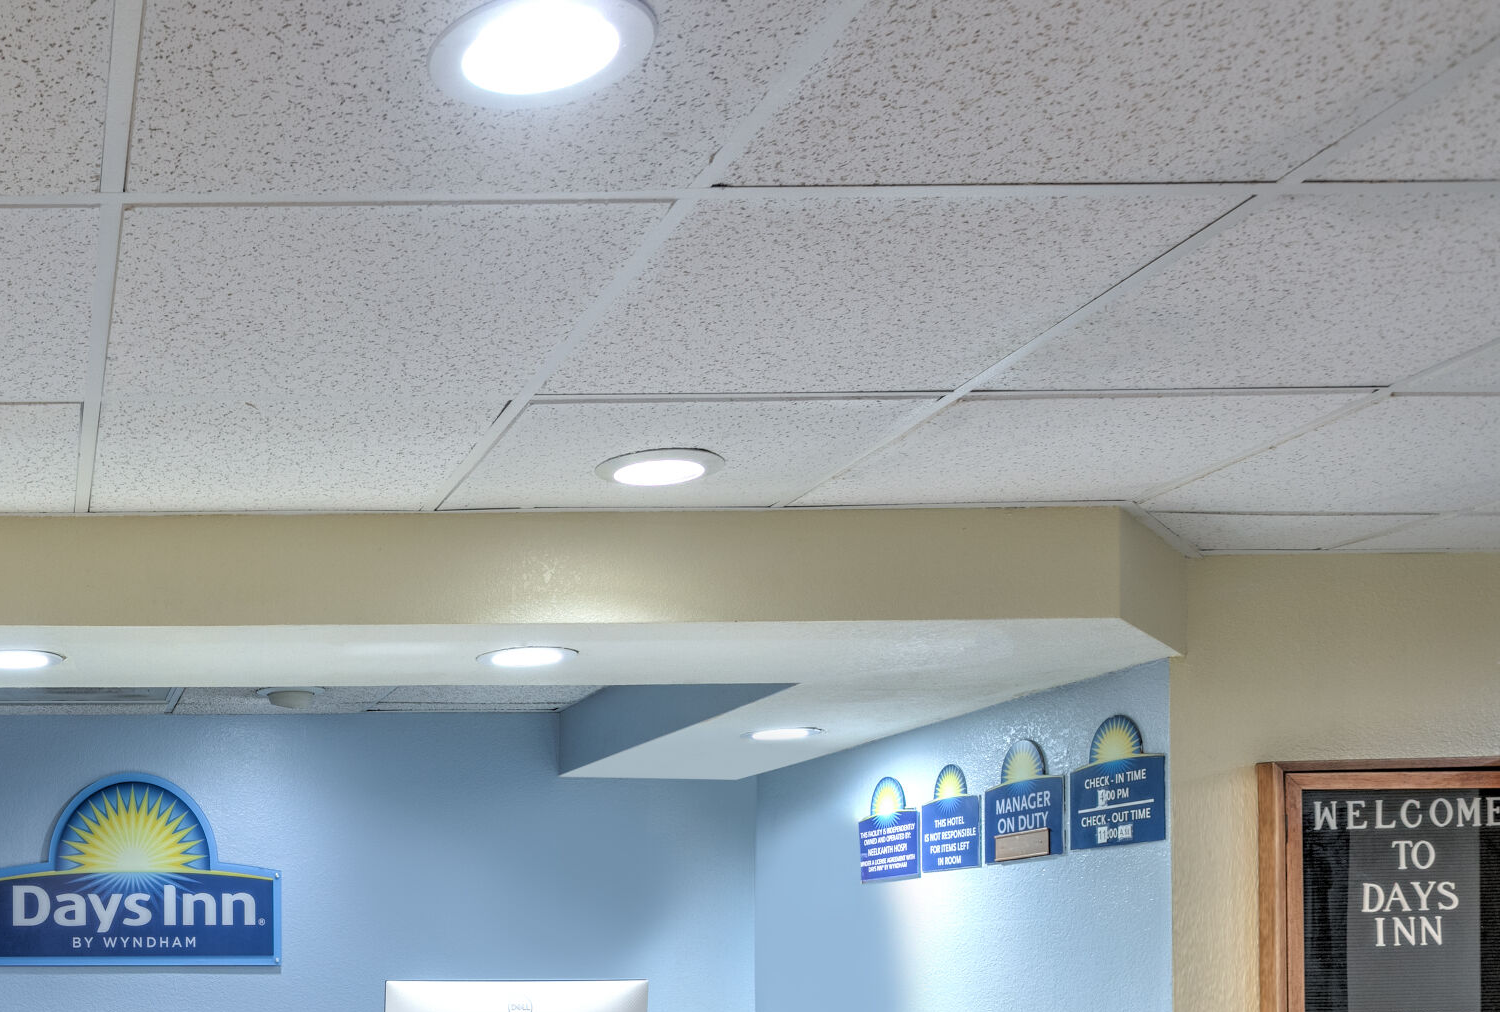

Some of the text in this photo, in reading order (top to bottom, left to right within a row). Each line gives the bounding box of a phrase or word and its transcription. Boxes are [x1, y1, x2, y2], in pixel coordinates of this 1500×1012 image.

[1084, 775, 1110, 789] CHECK
[1115, 773, 1125, 784] IN
[1126, 768, 1147, 782] TIME
[995, 790, 1051, 815] MANAGER
[1117, 787, 1129, 799] PM
[934, 816, 964, 828] THIS HOTEL
[997, 811, 1049, 834] ON DUTY
[1081, 814, 1107, 828] CHECK
[1111, 810, 1130, 823] OUT
[1130, 807, 1151, 820] TIME
[1313, 797, 1500, 831] WELCOME
[930, 832, 941, 842] NOT
[942, 827, 976, 840] RESPONSIBLE
[930, 841, 970, 854] FOR ITEMS LEFT
[1392, 840, 1436, 870] TO
[938, 855, 961, 866] IN ROOM
[1361, 881, 1459, 913] DAYS
[12, 885, 152, 933] Days
[72, 936, 197, 948] BY WYNDHAM
[1374, 916, 1443, 947] INN
